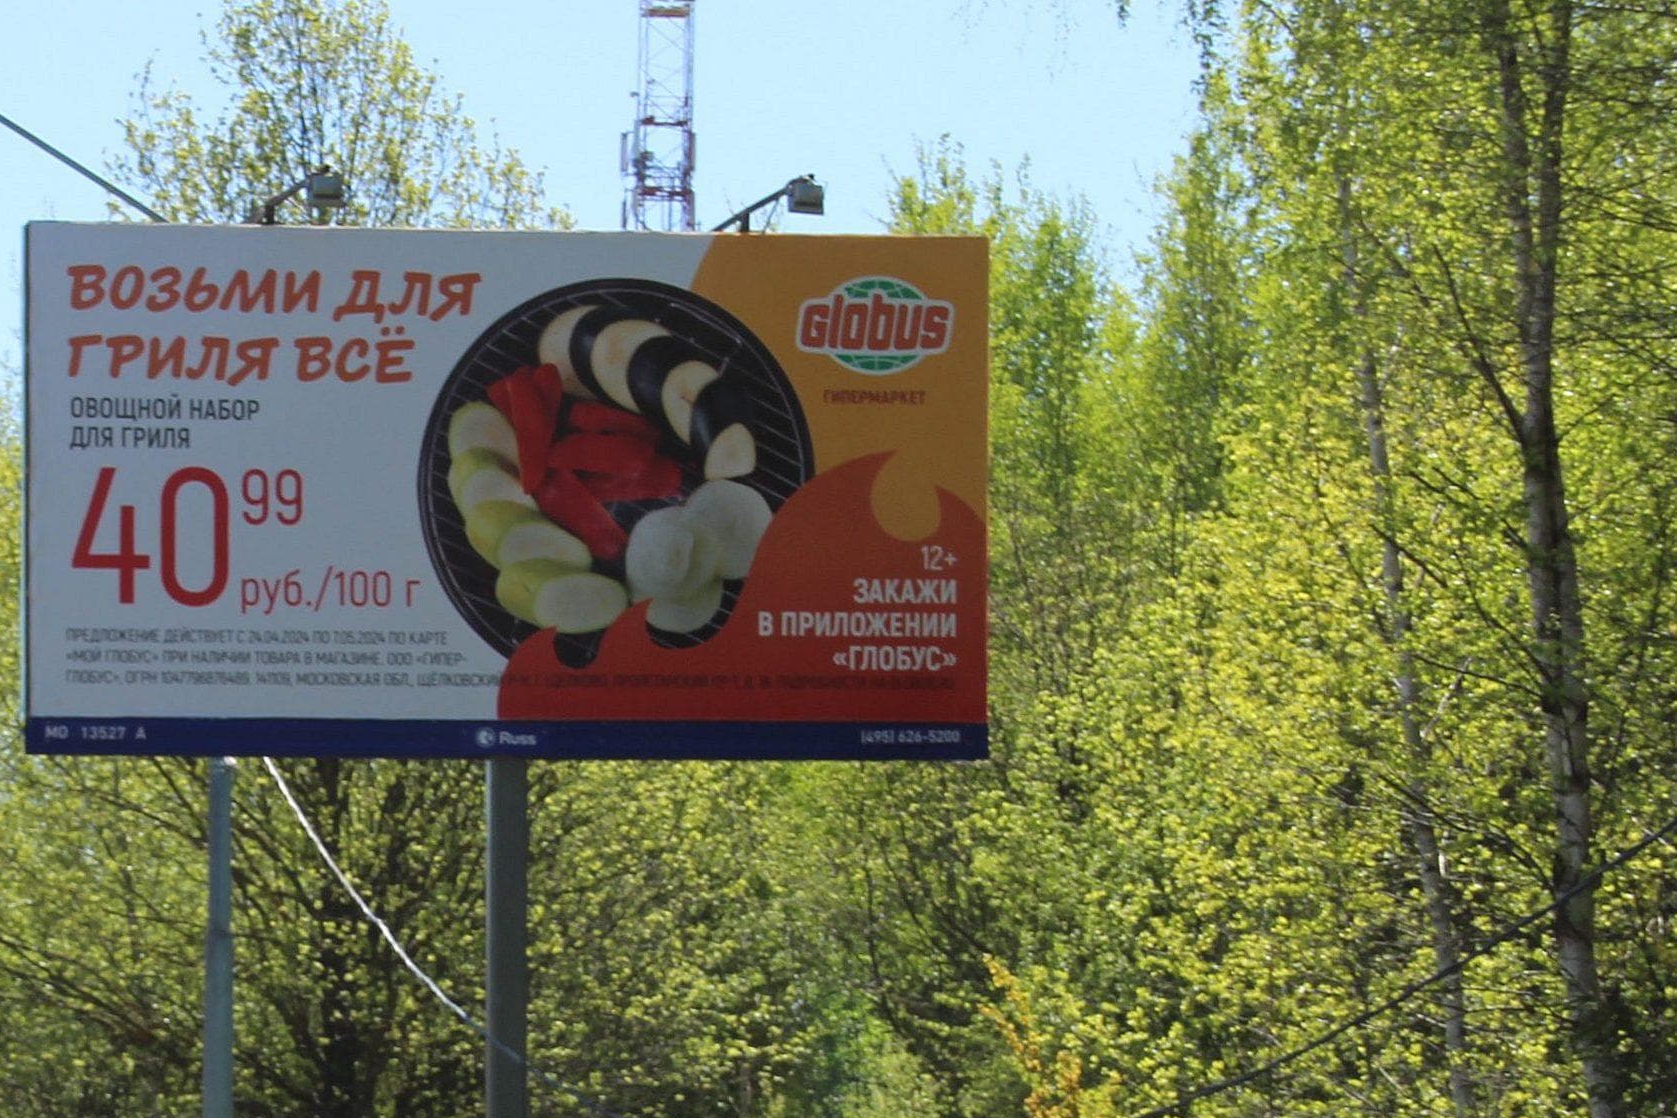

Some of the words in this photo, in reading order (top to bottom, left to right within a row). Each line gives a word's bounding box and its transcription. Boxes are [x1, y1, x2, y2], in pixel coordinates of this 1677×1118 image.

[66, 264, 321, 315] ВОЗЬМИ
[332, 270, 482, 323] ДЛЯ
[67, 334, 280, 387] ГРИЛЯ
[294, 326, 415, 384] ВСЁ
[70, 394, 182, 421] ОВОЩНОЙ
[188, 398, 261, 421] НАБОР
[69, 425, 114, 450] ДЛЯ
[122, 426, 191, 449] ГРИЛЯ
[71, 465, 231, 608] 40
[240, 468, 304, 527] 99
[920, 545, 959, 571] 12+
[240, 565, 393, 615] руб./100
[404, 578, 422, 608] г
[852, 578, 959, 605] ЗАКАЖИ
[65, 628, 160, 643] ПРЕДЛОЖЕНИЕ
[163, 627, 234, 644] ДЕЙСТВУЕТ
[408, 631, 448, 645] КАРТЕ
[758, 611, 774, 637] В
[780, 612, 958, 638] ПРИЛОЖЕНИИ
[253, 650, 302, 665] ТОВАРА
[831, 646, 959, 672] «ГЛОБУС»
[295, 672, 381, 686] МОСКОВСКАЯ
[80, 726, 127, 741] 13527
[498, 730, 538, 746] Russ
[898, 729, 961, 744] 626-5200
